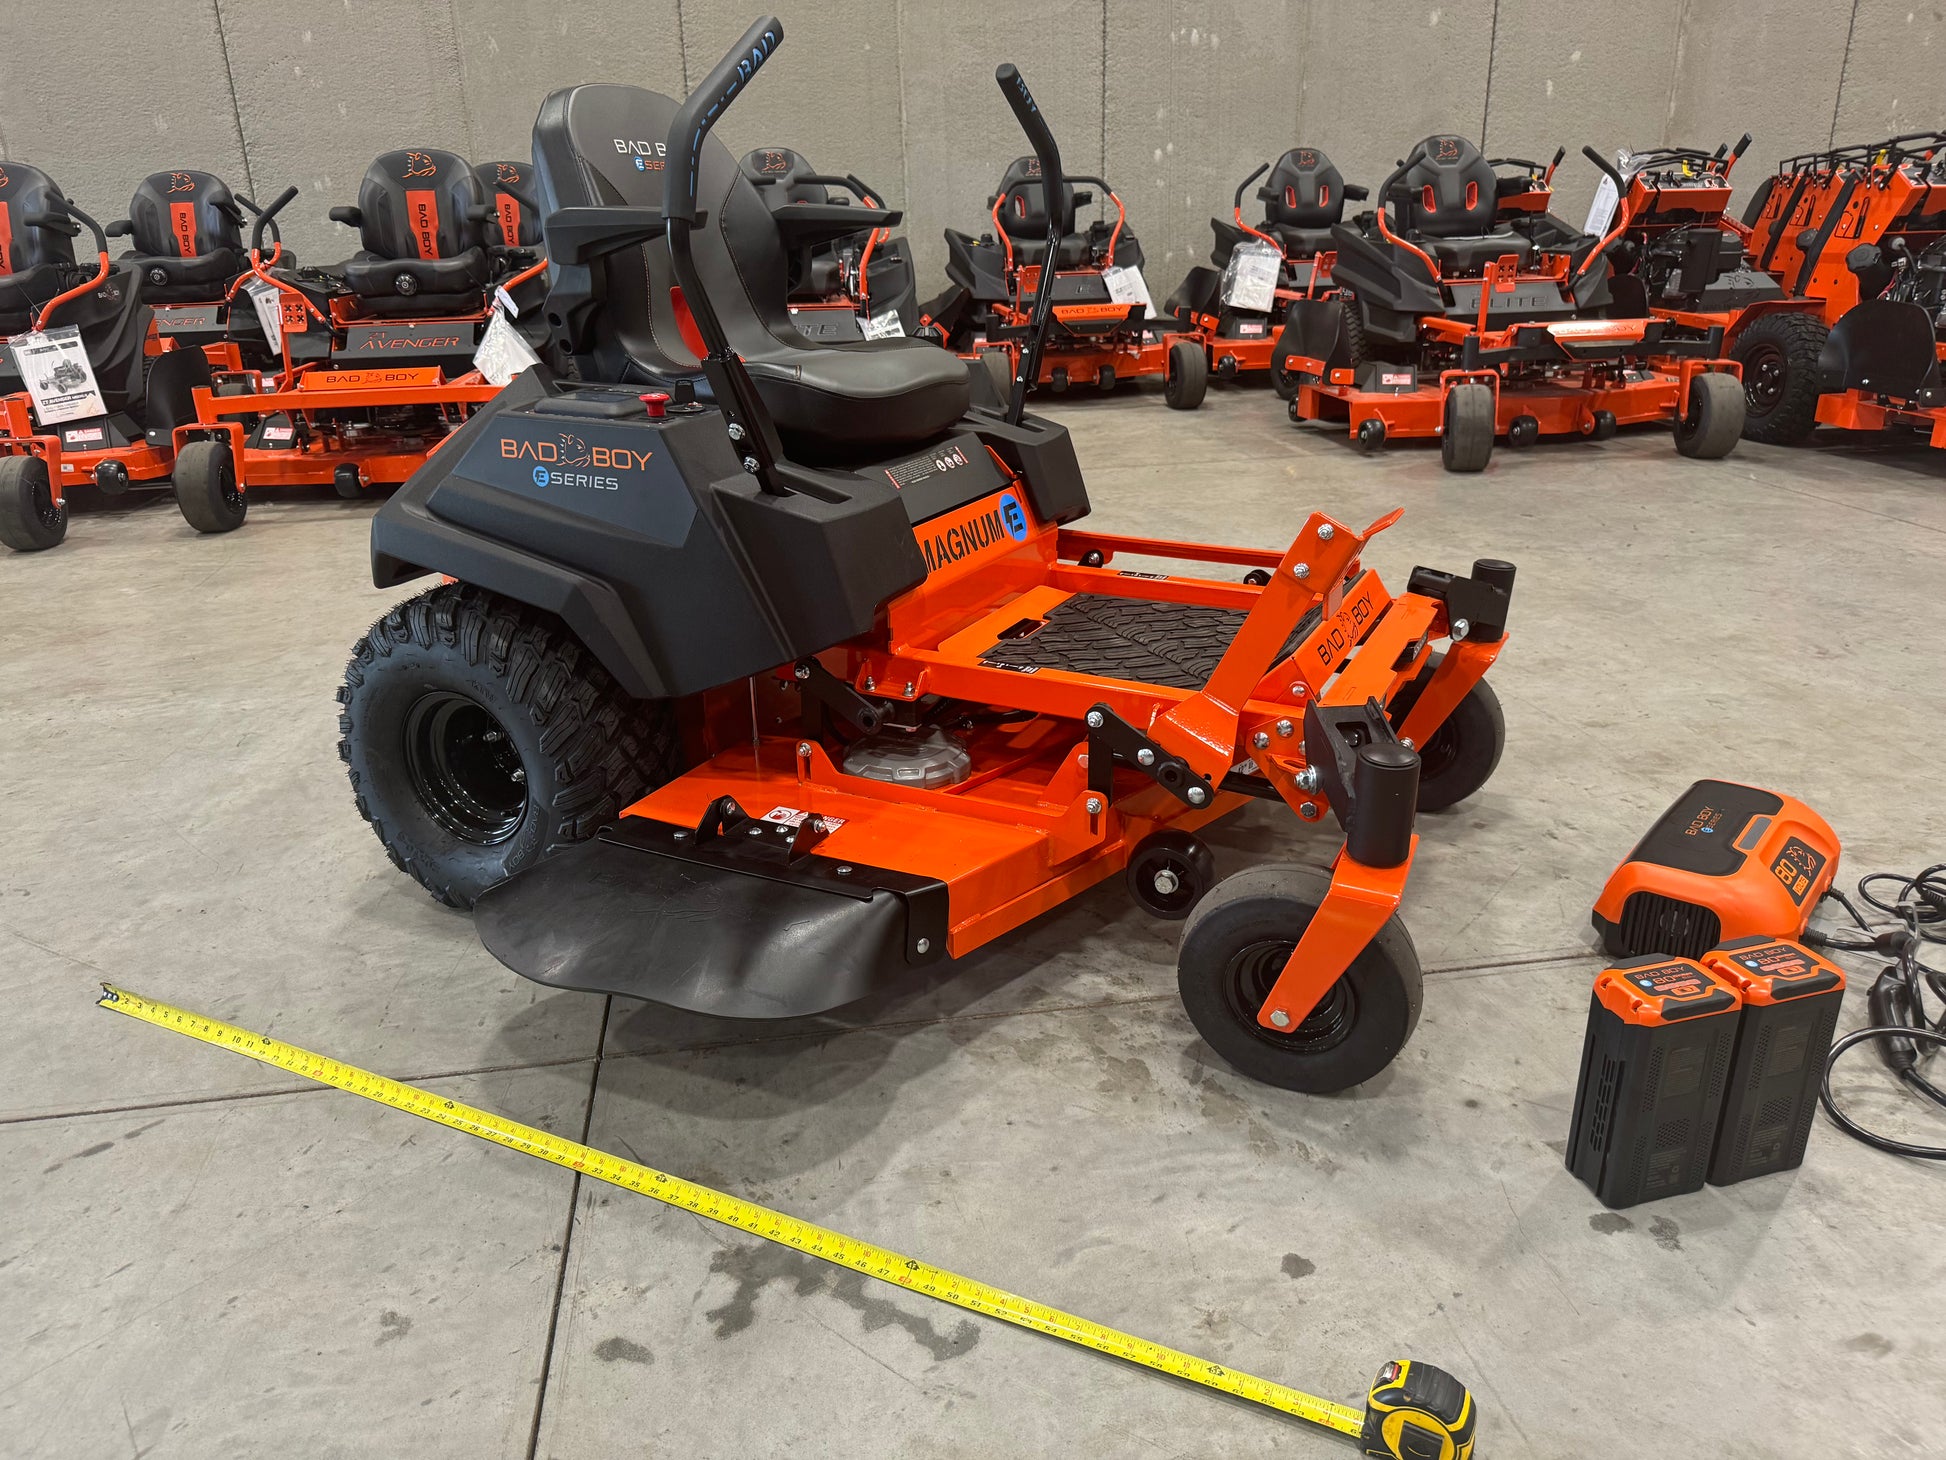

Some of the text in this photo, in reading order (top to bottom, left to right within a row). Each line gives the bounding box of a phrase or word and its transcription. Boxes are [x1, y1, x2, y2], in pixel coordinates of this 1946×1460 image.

[736, 31, 776, 84] BAD
[613, 139, 652, 156] BAD
[179, 212, 192, 254] BAD BOY
[418, 203, 433, 256] BAD BOY
[504, 203, 516, 244] BAD BOY
[359, 337, 460, 350] AVENGER
[326, 373, 419, 384] BAD BOY
[500, 439, 653, 471] BAD BOY
[550, 472, 619, 490] SERIES
[923, 510, 1005, 574] MAGNUM
[1317, 591, 1374, 666] BAD BOY
[1684, 806, 1714, 836] BAD BOY
[1774, 858, 1798, 885] 80
[1740, 947, 1786, 960] BAD BOY
[1757, 956, 1780, 964] 80
[1634, 966, 1685, 980] BAD BOY
[1653, 976, 1676, 984] 80
